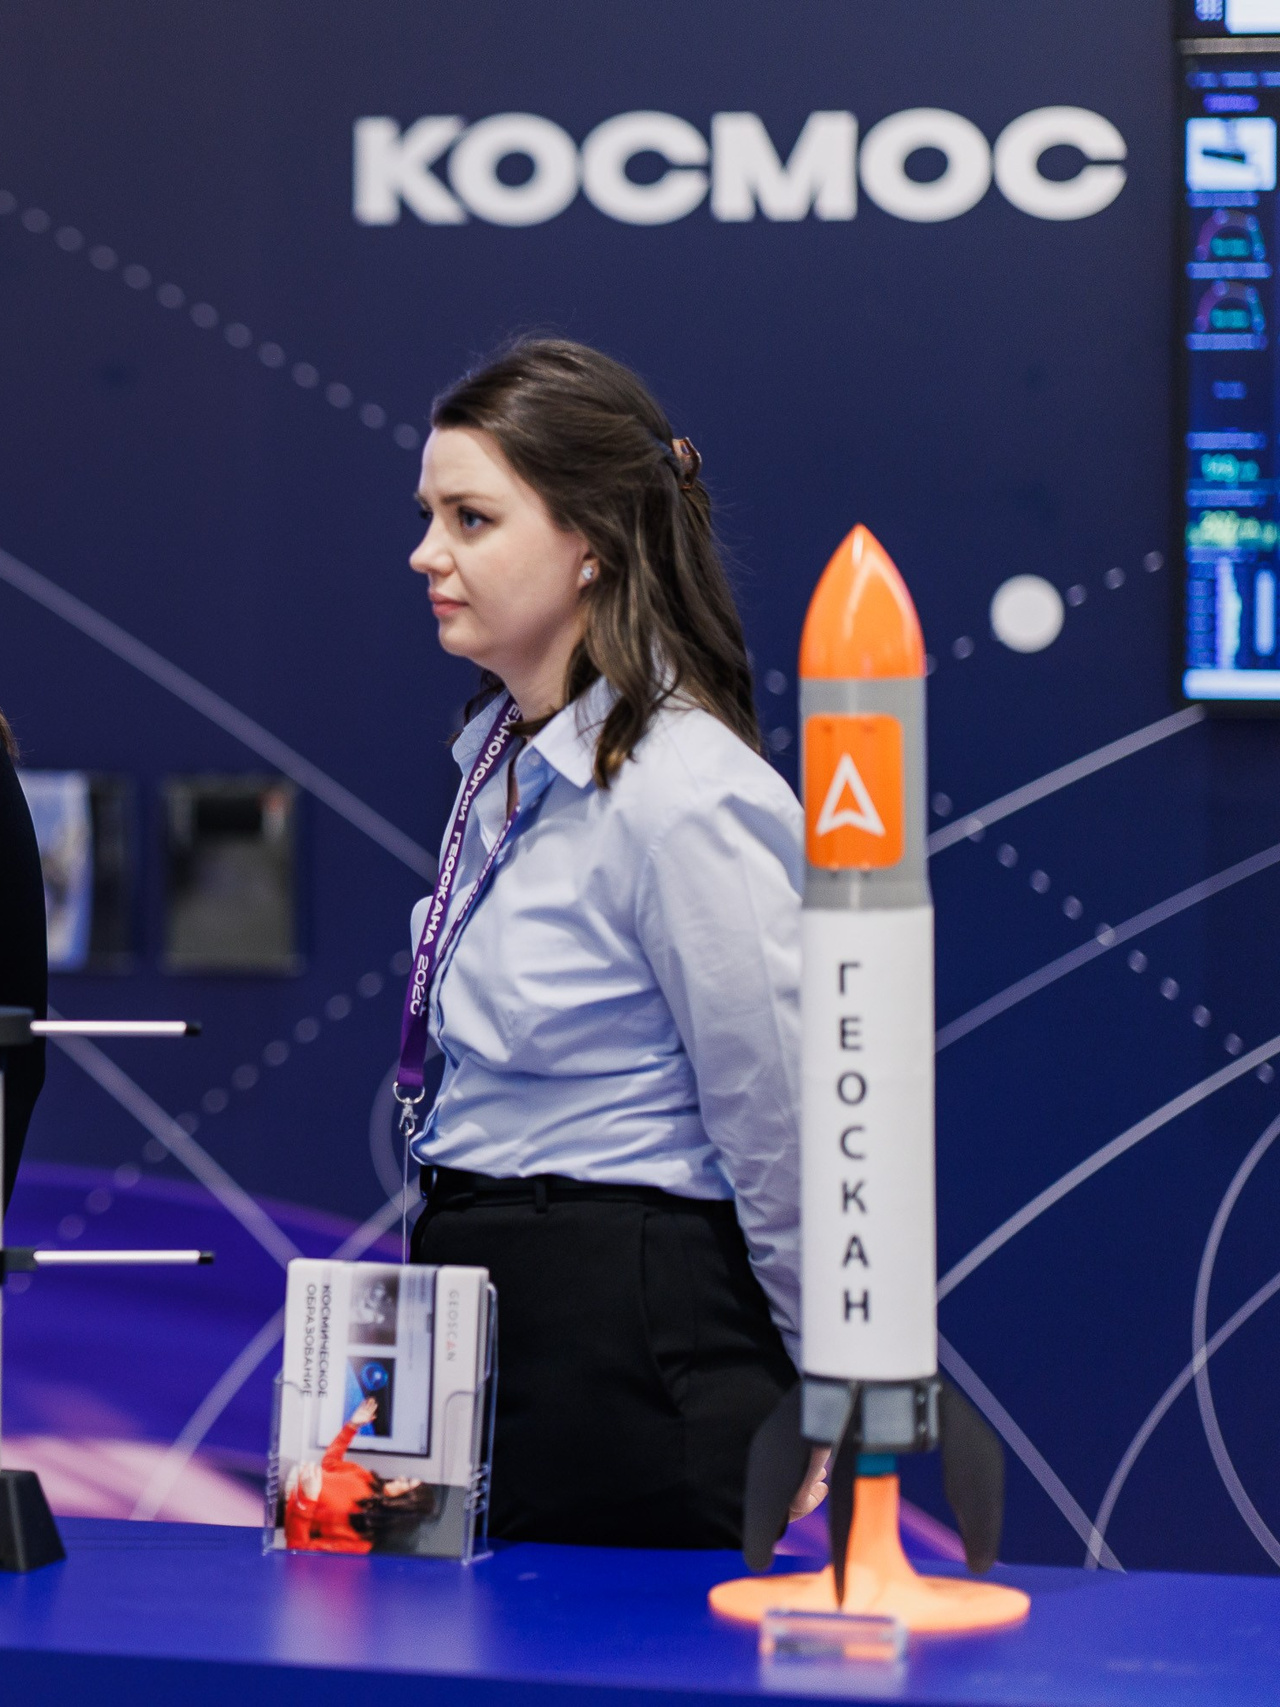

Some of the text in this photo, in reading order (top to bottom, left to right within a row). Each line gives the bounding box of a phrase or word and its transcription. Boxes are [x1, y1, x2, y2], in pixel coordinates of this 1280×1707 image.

[353, 105, 1127, 227] КОСМОС
[458, 704, 520, 822] ЕХНОЛОГИИ
[423, 831, 462, 945] ГЕОСКАНА
[836, 961, 870, 1324] ГЕОСКАН
[302, 1282, 316, 1398] ОБРАЗОВАНИЕ
[317, 1284, 331, 1399] КОСМИЧЕСКОЕ
[445, 1288, 460, 1363] GEOSCAN
